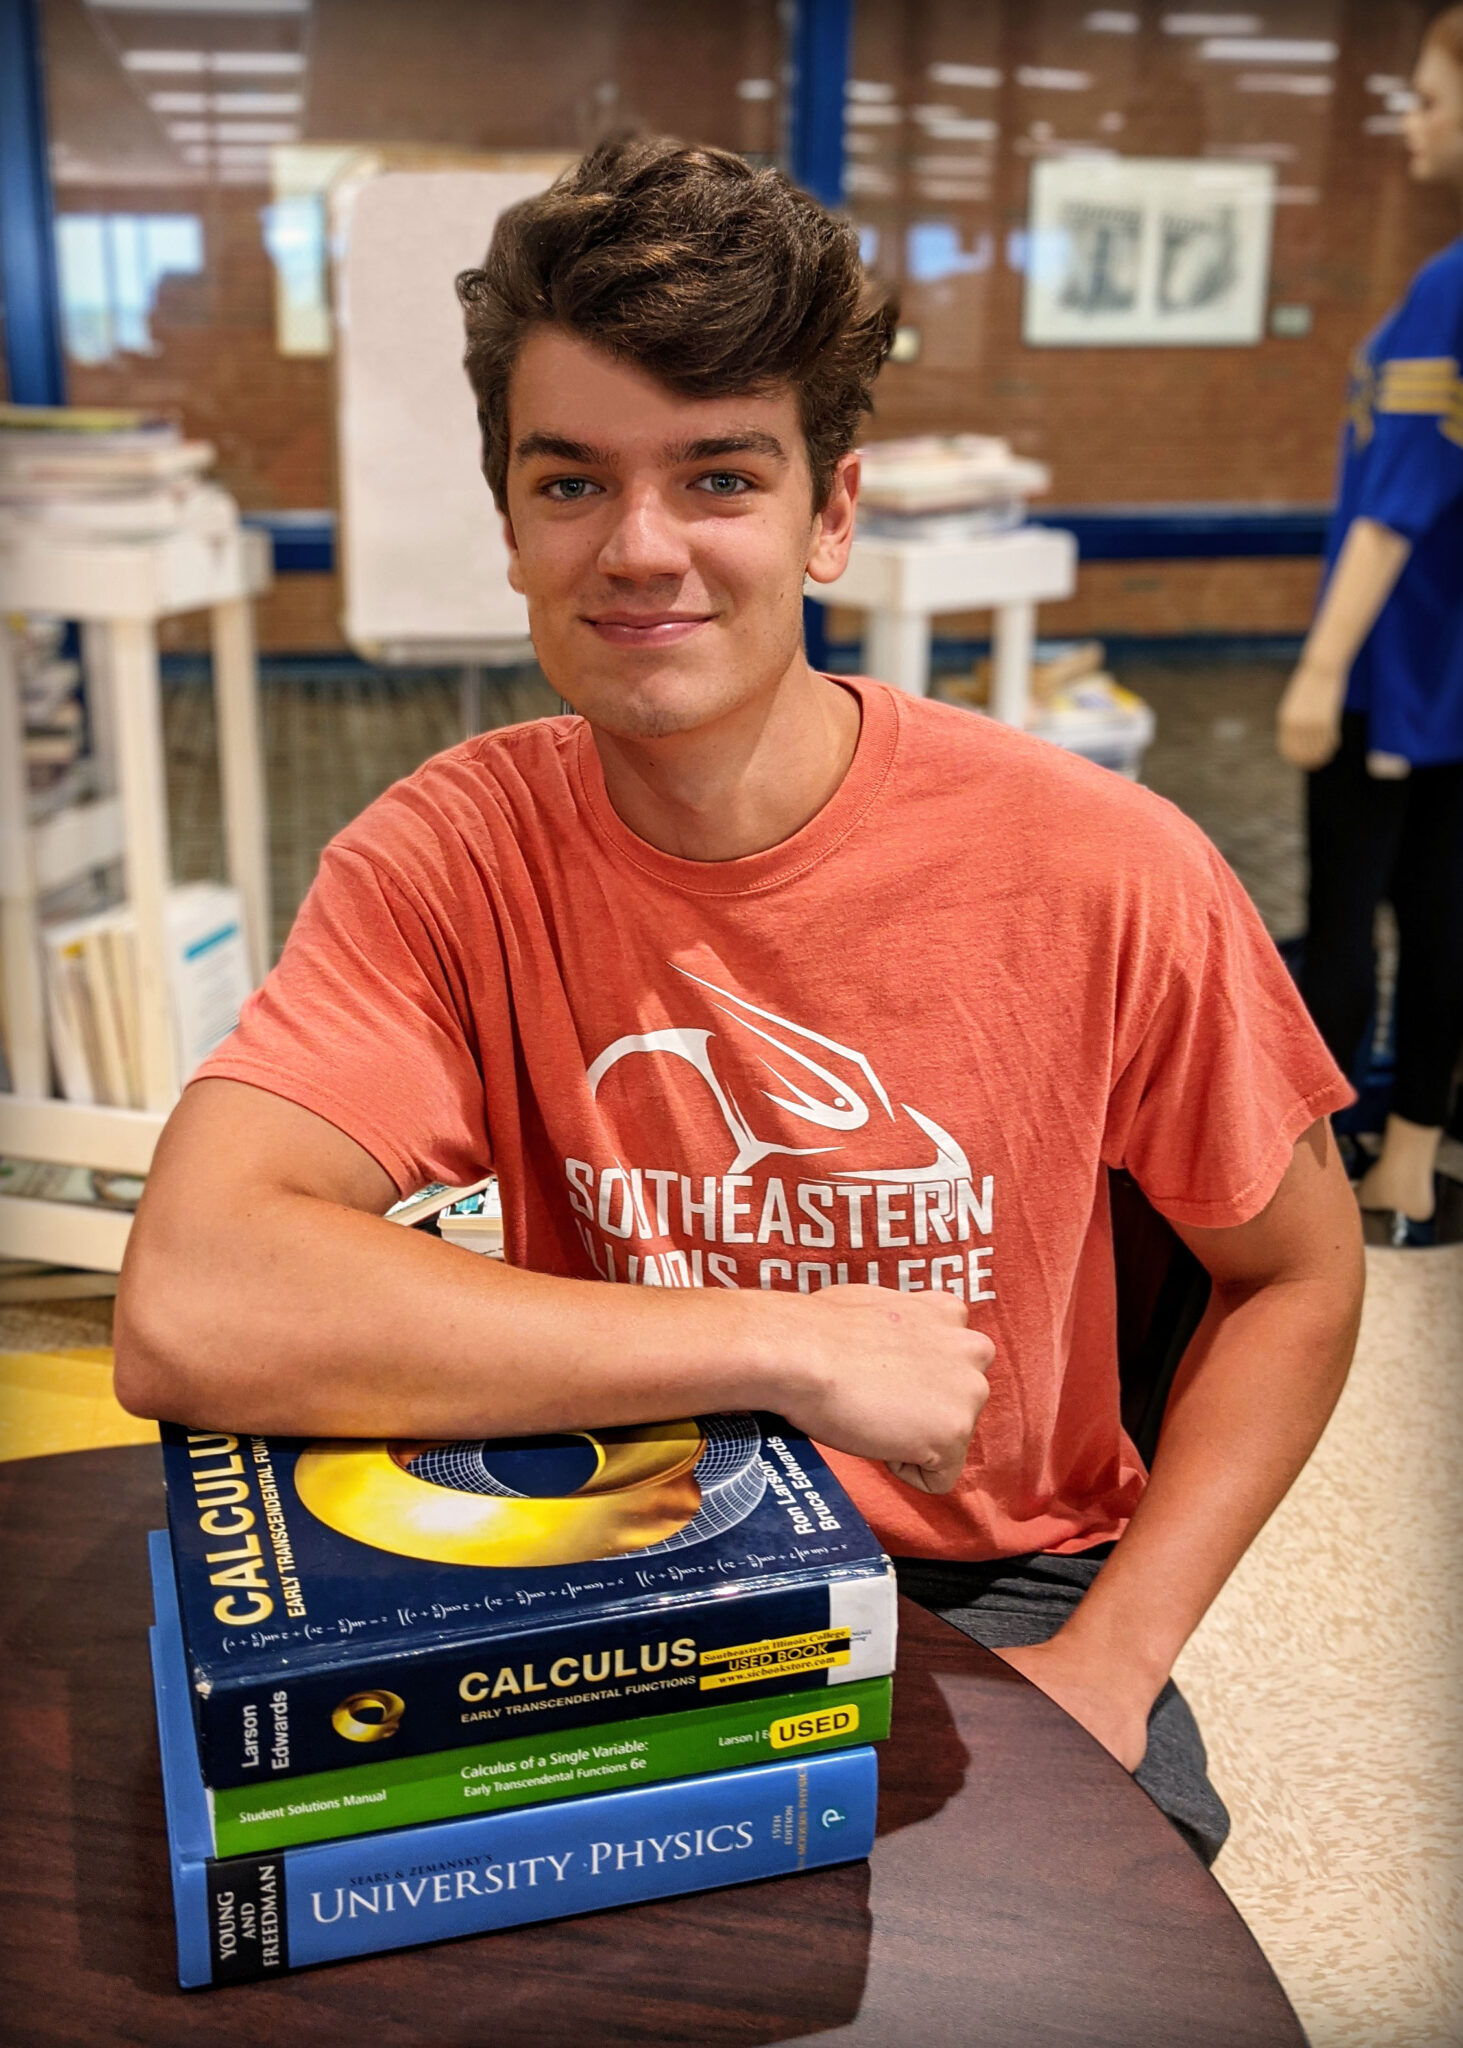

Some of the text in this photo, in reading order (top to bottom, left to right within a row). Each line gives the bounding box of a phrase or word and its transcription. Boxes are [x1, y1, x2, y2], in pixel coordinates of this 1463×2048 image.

[758, 1461, 816, 1535] Ron Larson
[766, 1436, 841, 1531] Bruce Edwards
[187, 1433, 274, 1626] CALCULU
[257, 1464, 297, 1574] TRANSCENDENTAL
[281, 1576, 307, 1618] EARLY
[458, 1638, 697, 1703] CALCULUS
[703, 1643, 770, 1662] Southeastern
[772, 1638, 807, 1650] Illinois
[809, 1630, 847, 1644] College
[718, 1656, 836, 1684] www.sicbookstore.com
[728, 1643, 829, 1671] USED BOOK
[460, 1675, 697, 1724] EARLY TRANSCENDENTAL FUNCTIONS
[241, 1704, 259, 1768] Larson
[271, 1690, 289, 1770] Edwards
[718, 1732, 753, 1746] Larson
[779, 1712, 850, 1742] USED
[460, 1740, 649, 1780] Calculus of a Single Variable:
[464, 1758, 647, 1799] Early Transcendental Functions 6e
[239, 1789, 388, 1824] Student Solutions Manual
[311, 1821, 753, 1924] UNIVERSITY PHYSICS
[218, 1890, 236, 1960] YOUNG
[240, 1902, 256, 1939] AND
[258, 1865, 280, 1968] FREEDMAN
